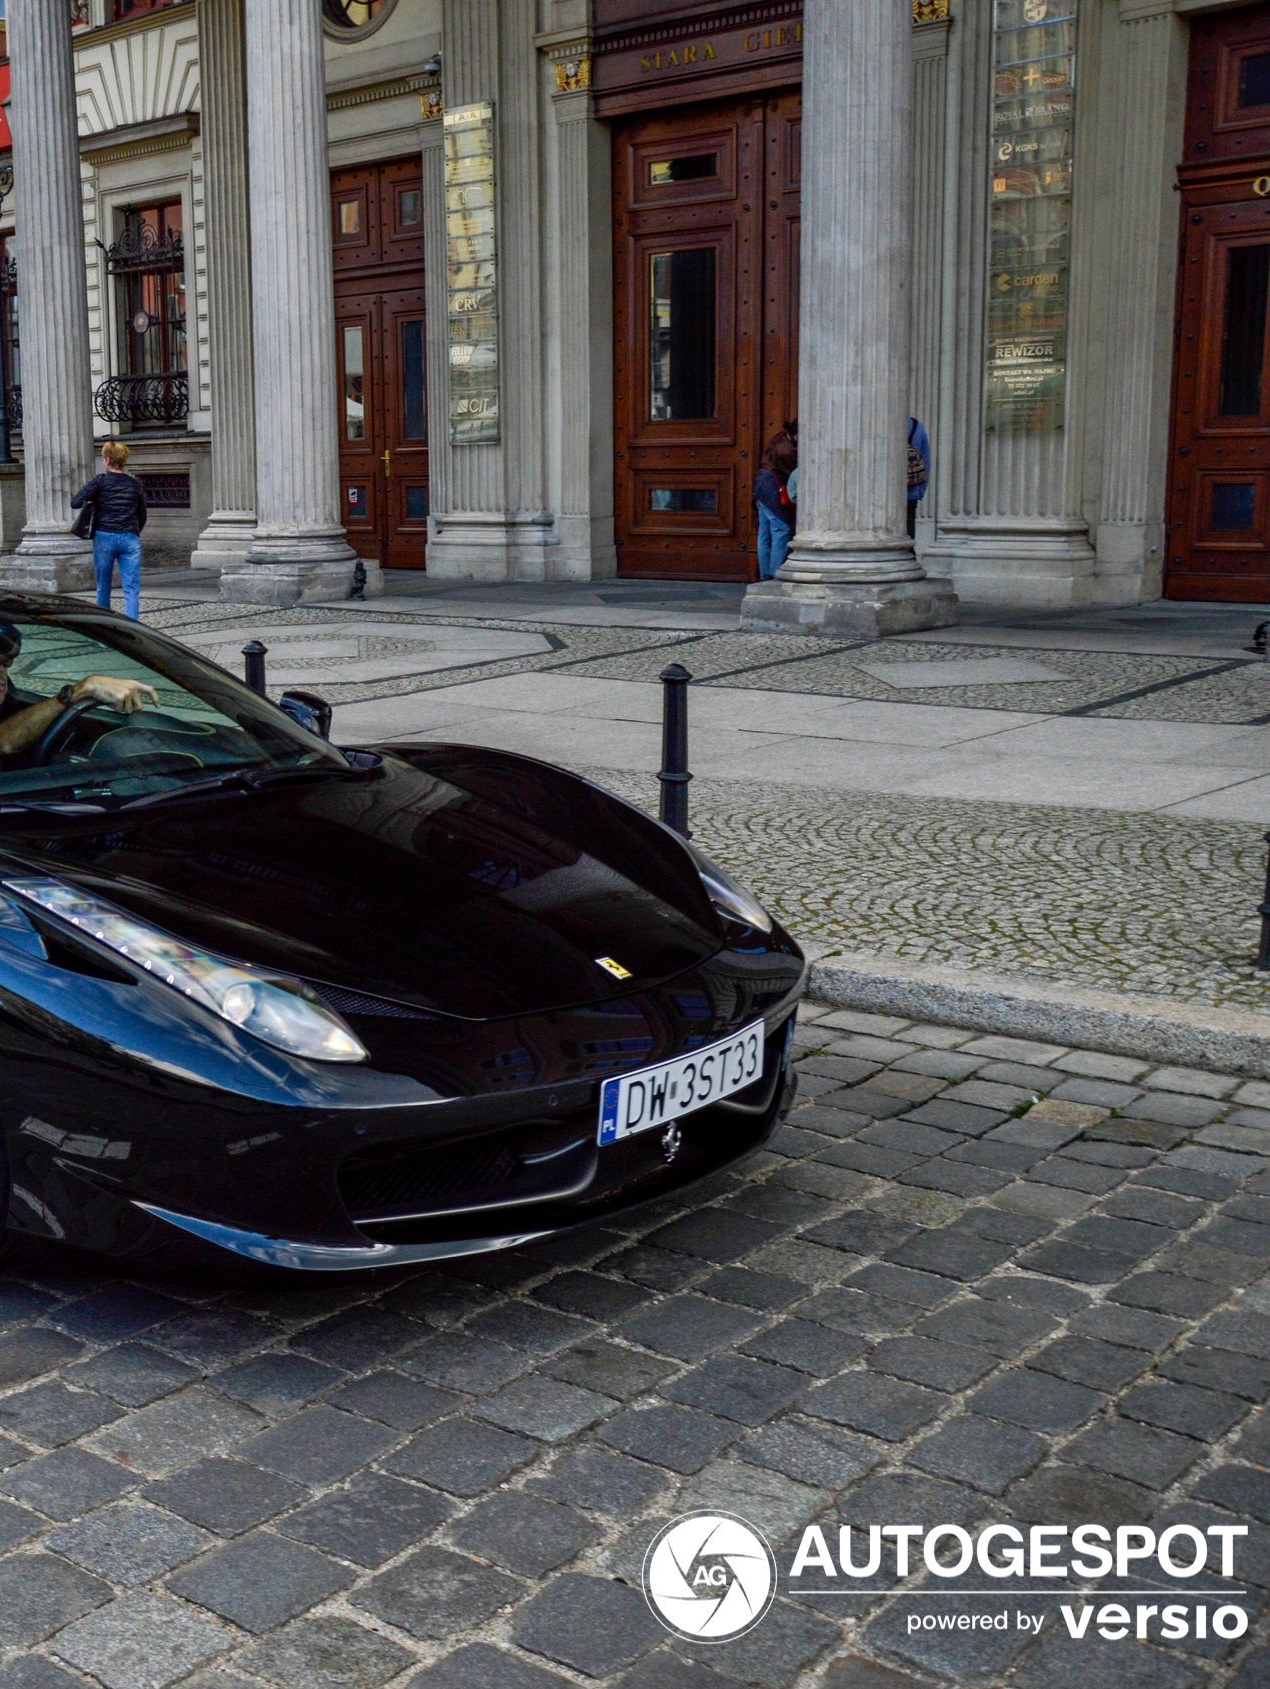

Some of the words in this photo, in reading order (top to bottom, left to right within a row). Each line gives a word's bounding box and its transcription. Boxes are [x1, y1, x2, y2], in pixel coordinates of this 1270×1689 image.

[640, 41, 717, 73] STARA
[1014, 273, 1059, 286] carden
[995, 344, 1054, 358] REWIZOR
[626, 1070, 670, 1130] DW
[679, 1033, 758, 1109] 3ST33
[602, 1118, 617, 1134] PL
